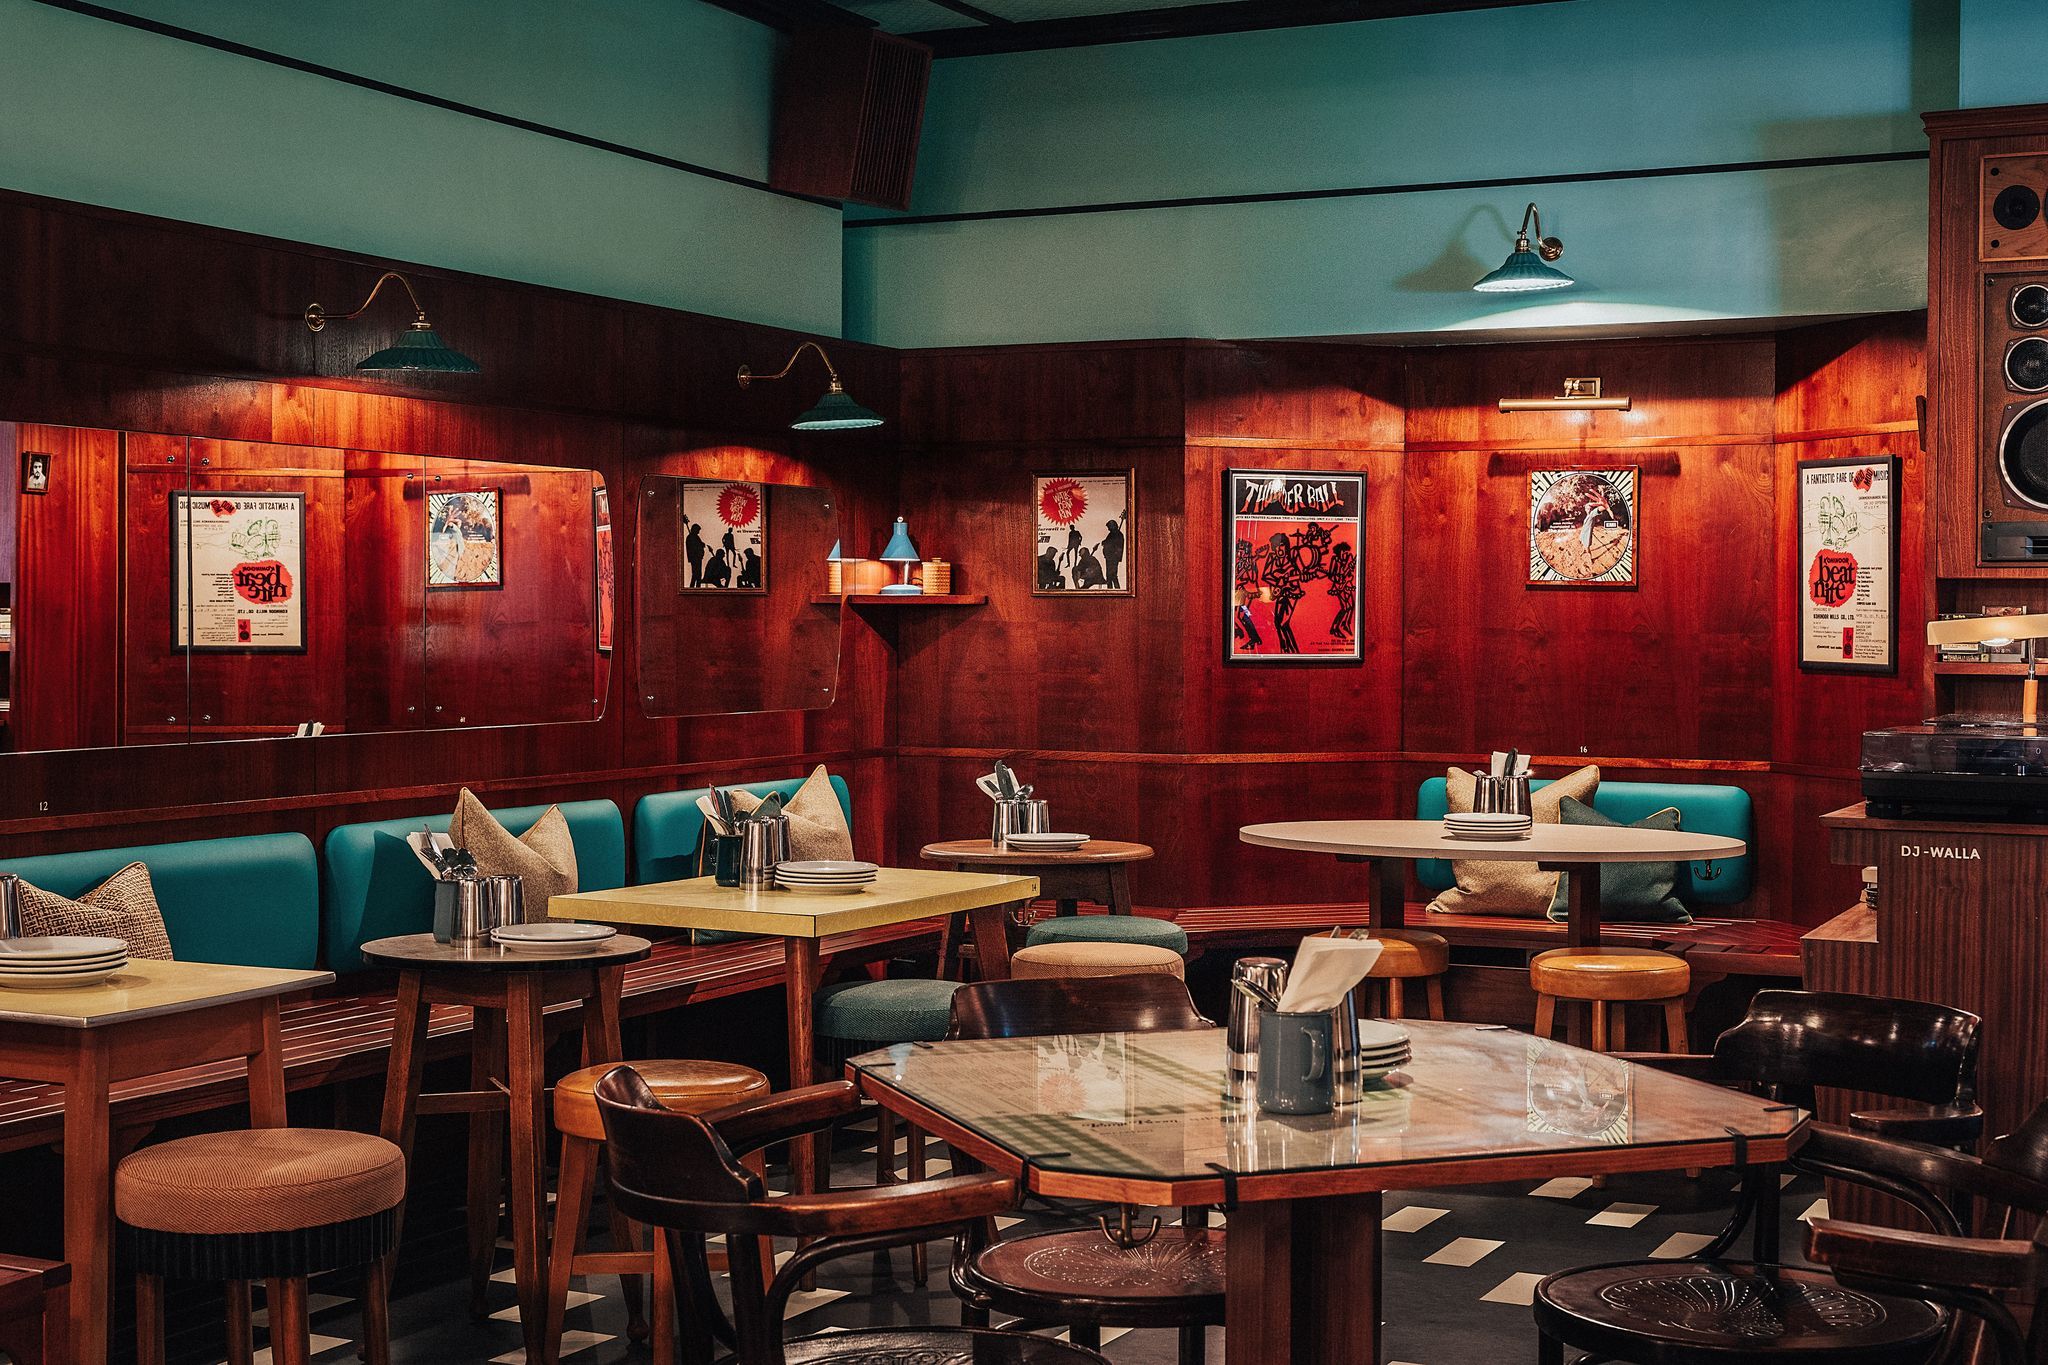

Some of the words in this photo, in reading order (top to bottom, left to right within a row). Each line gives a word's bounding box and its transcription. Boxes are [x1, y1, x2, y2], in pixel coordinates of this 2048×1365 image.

[1811, 472, 1834, 485] FANTASTIC
[1836, 472, 1847, 483] FARE
[1307, 482, 1345, 513] BALL
[1819, 555, 1855, 584] beat
[1814, 579, 1846, 604] nite
[1580, 745, 1588, 753] 16
[39, 801, 49, 811] 12
